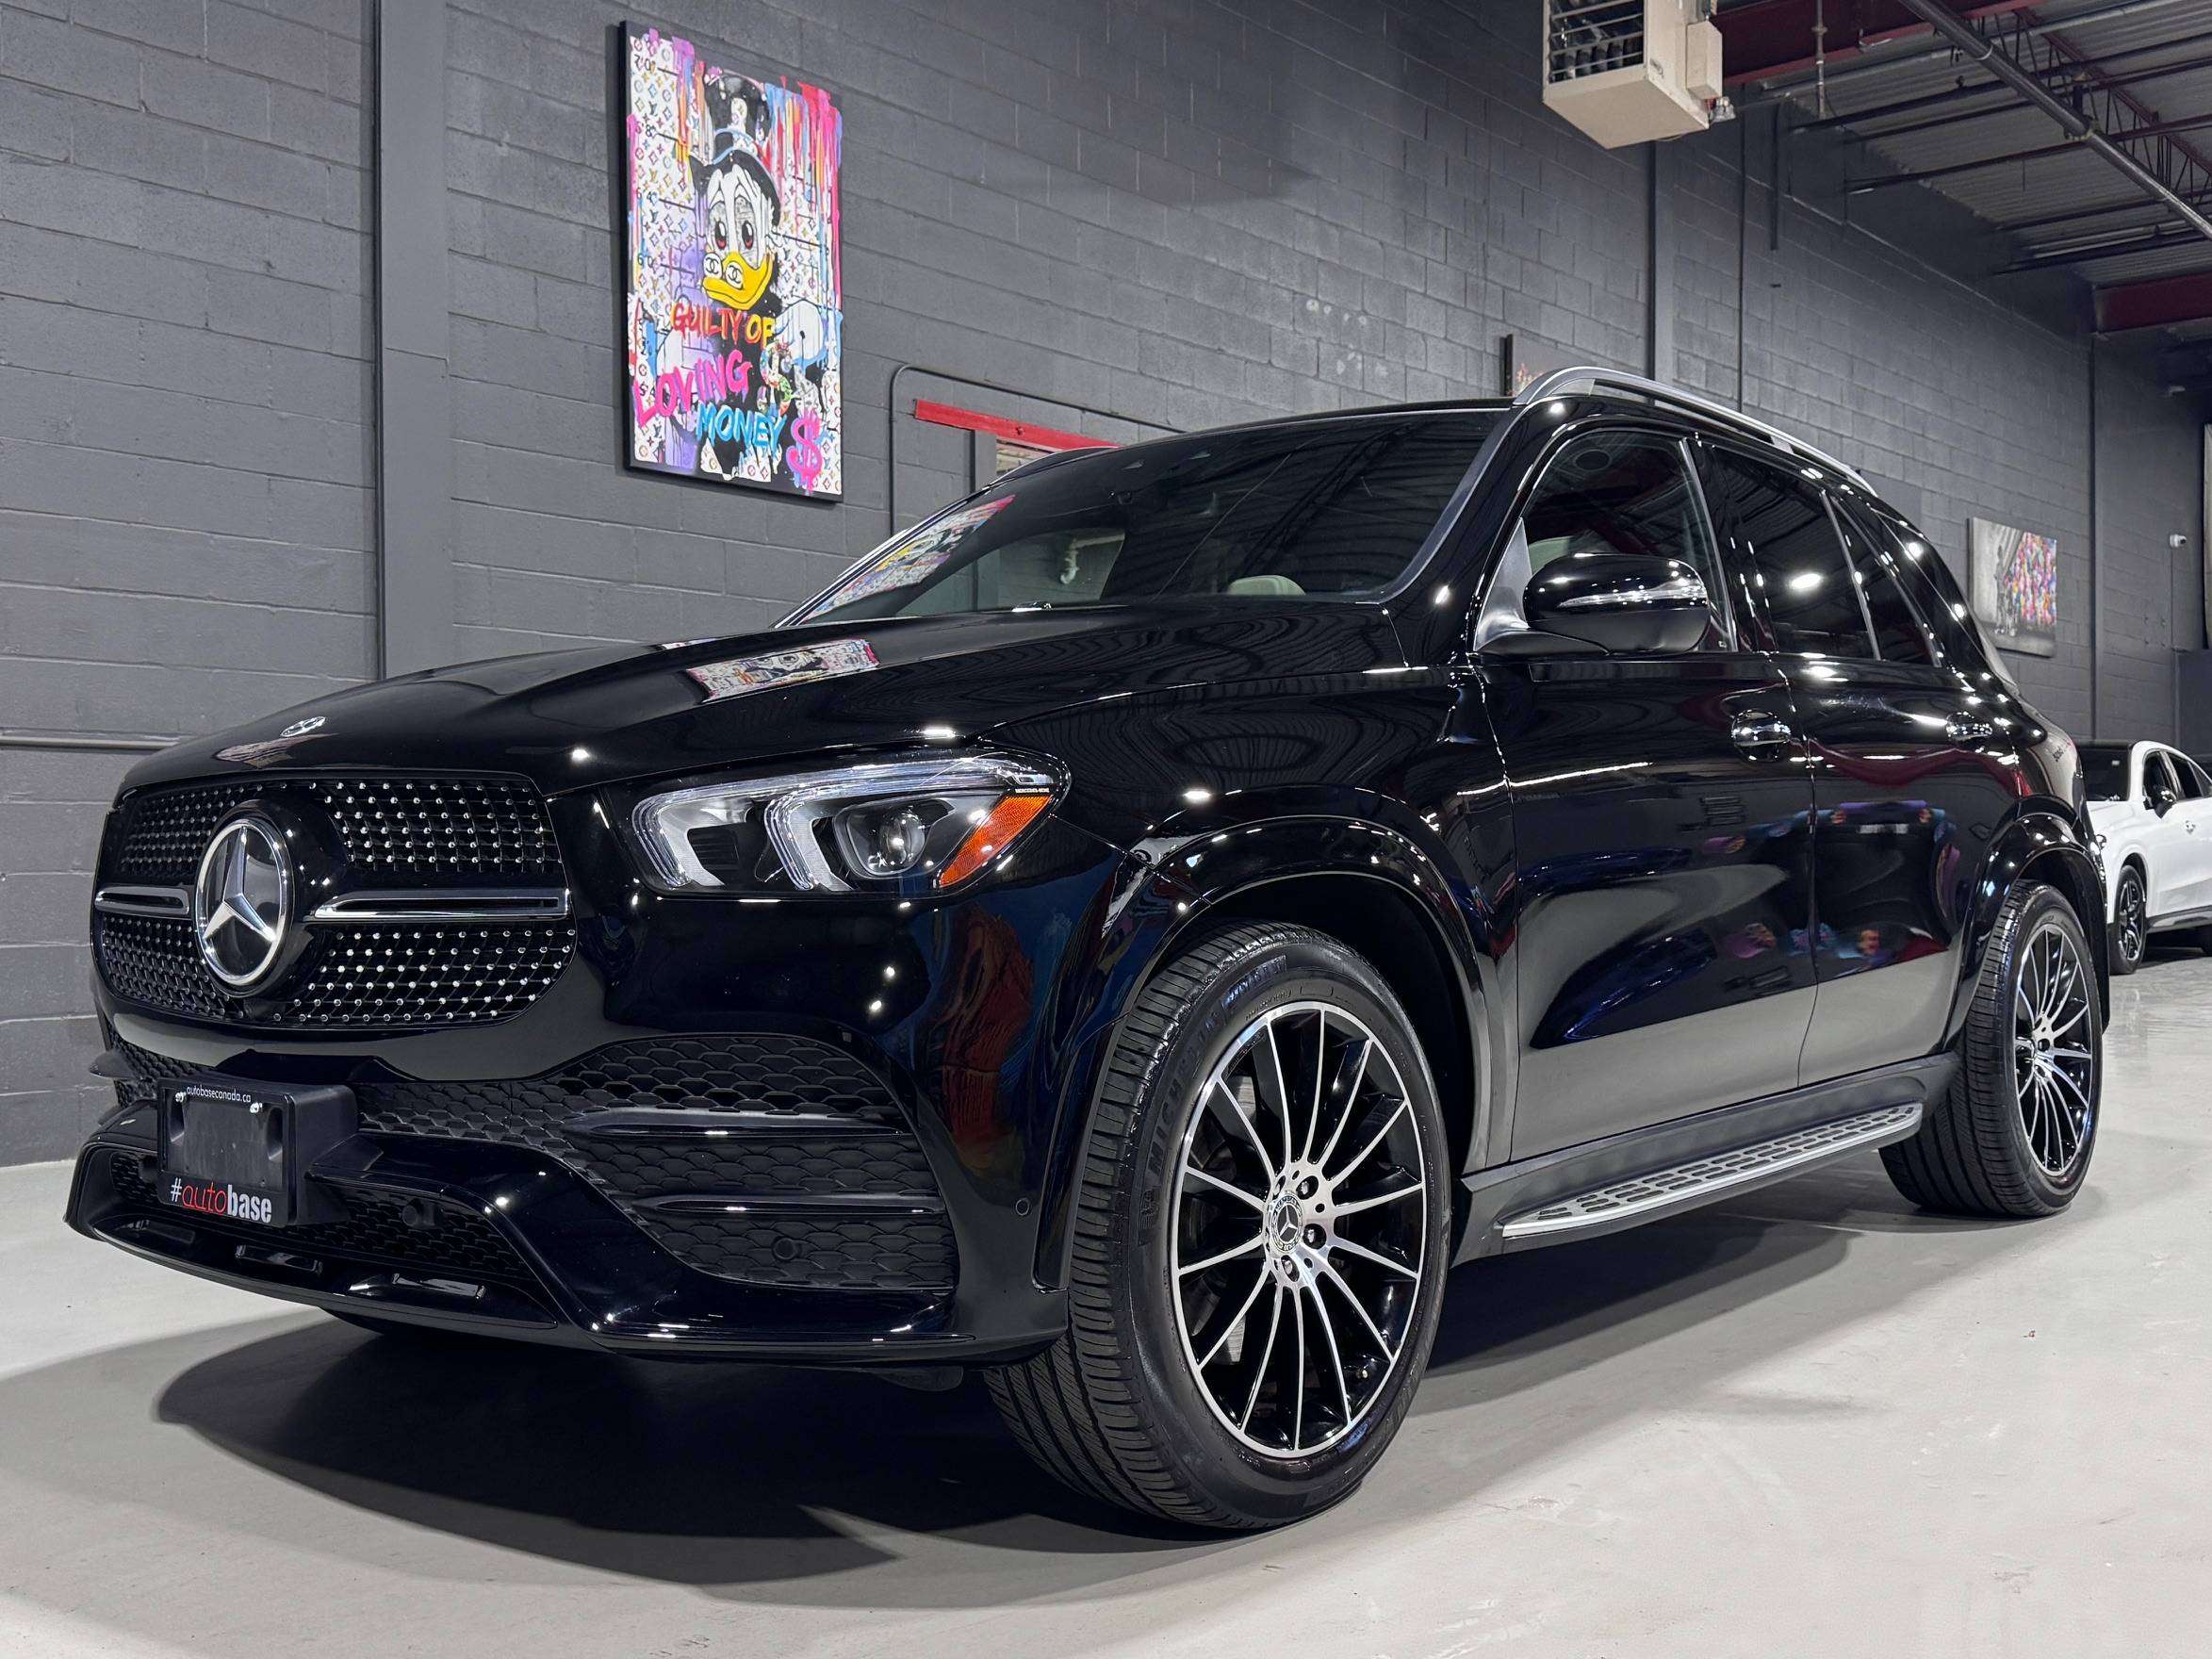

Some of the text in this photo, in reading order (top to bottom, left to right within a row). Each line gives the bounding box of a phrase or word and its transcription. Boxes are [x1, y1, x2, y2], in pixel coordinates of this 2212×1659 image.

[670, 302, 775, 345] GUILTY OF
[632, 349, 752, 428] LOVING
[696, 403, 786, 455] MONEY
[170, 1177, 272, 1224] #autobase
